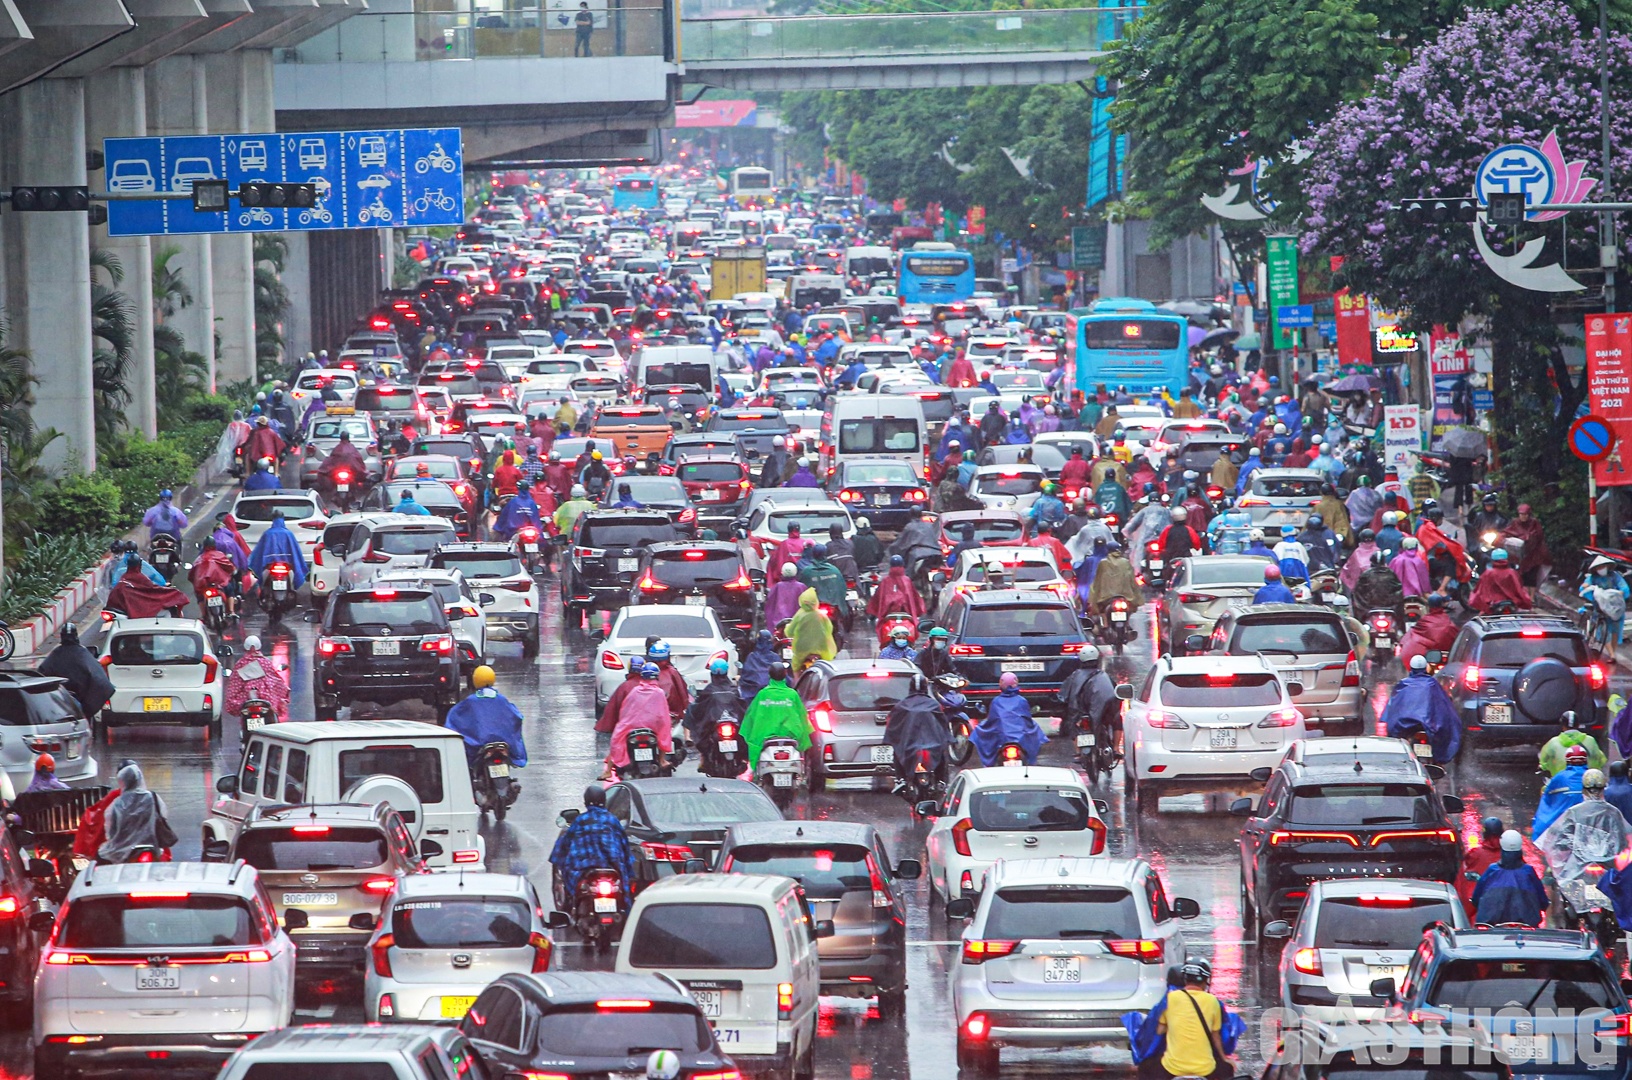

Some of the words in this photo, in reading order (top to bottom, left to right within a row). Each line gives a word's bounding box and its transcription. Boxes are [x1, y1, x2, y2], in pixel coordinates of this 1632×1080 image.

[1591, 386, 1610, 397] VIỆT
[1610, 386, 1630, 395] NAM
[1600, 398, 1623, 408] 2021
[1216, 729, 1231, 738] 29A
[1053, 958, 1071, 970] 30F
[148, 968, 168, 978] 30H
[1045, 970, 1080, 981] 347.88
[140, 978, 176, 988] 506.73
[1514, 1037, 1536, 1047] 30H
